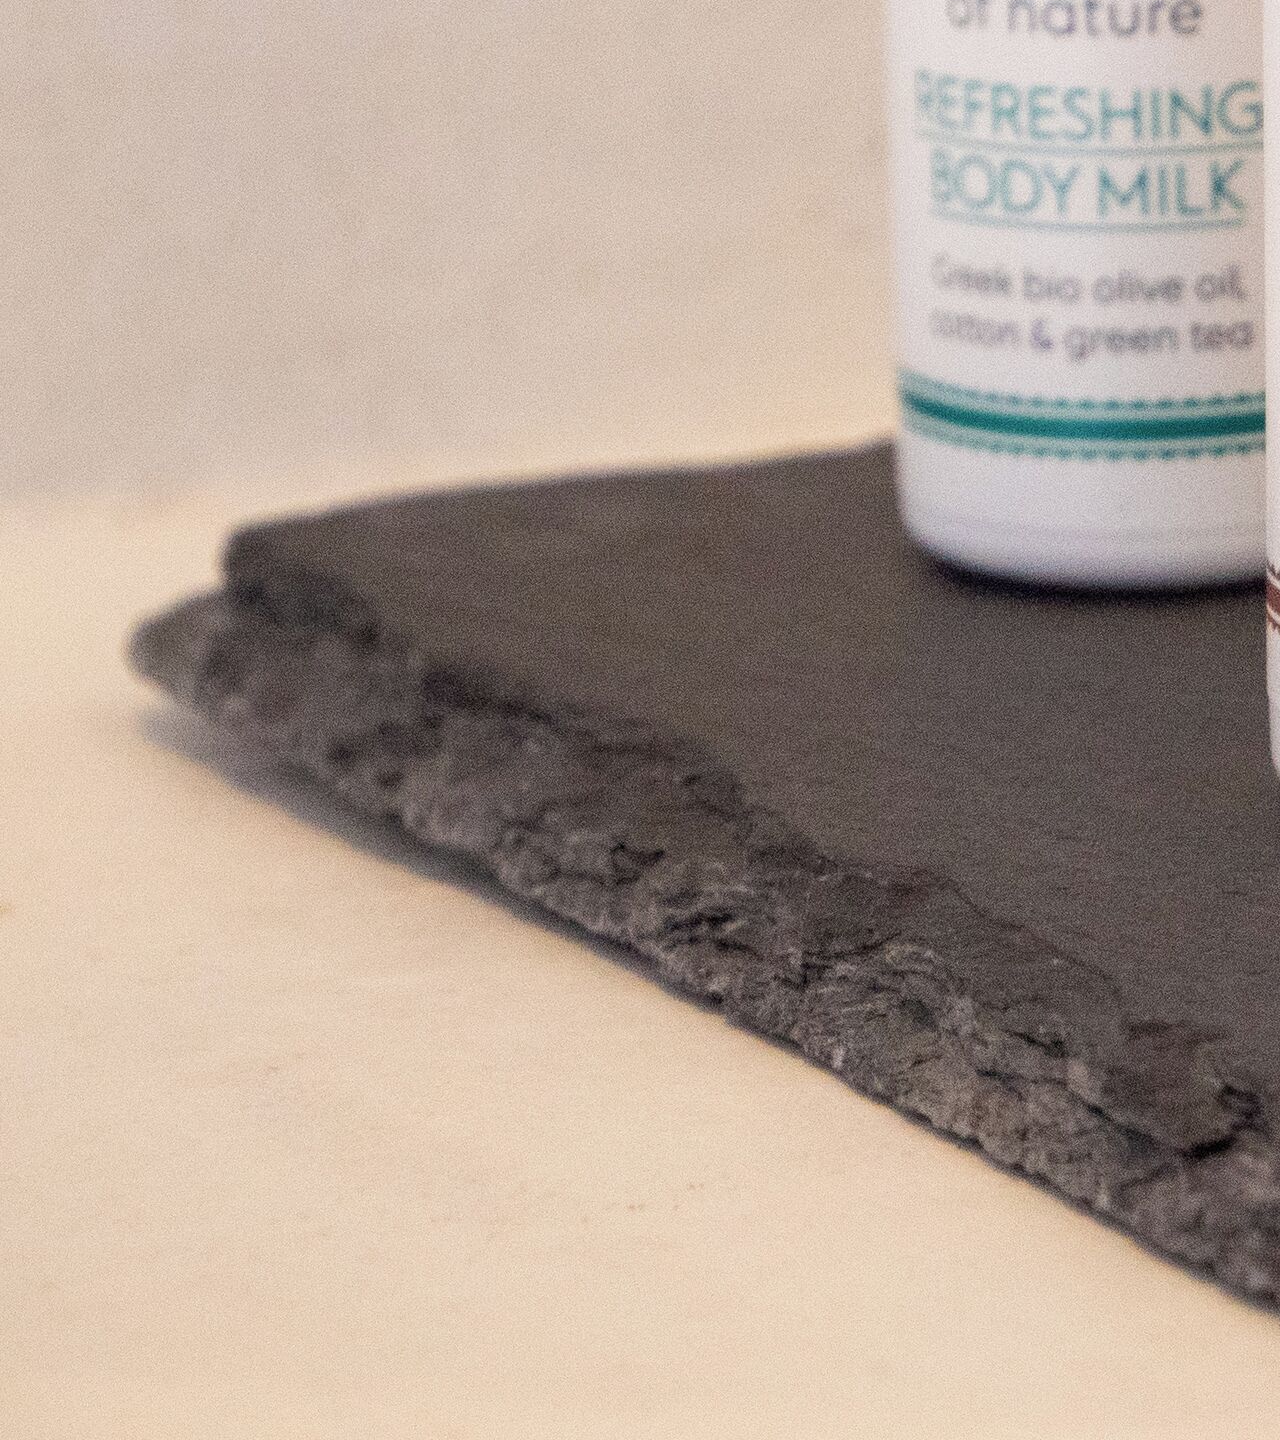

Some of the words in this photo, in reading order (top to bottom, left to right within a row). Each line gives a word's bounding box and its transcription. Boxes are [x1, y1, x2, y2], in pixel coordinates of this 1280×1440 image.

[913, 66, 1265, 143] REFRESHING
[930, 147, 1081, 215] BODY
[1097, 157, 1247, 217] MILK
[1022, 265, 1082, 303] bio
[1091, 268, 1184, 305] olive
[1031, 317, 1053, 351] &
[1063, 324, 1180, 366] green
[1188, 320, 1254, 351] tea
